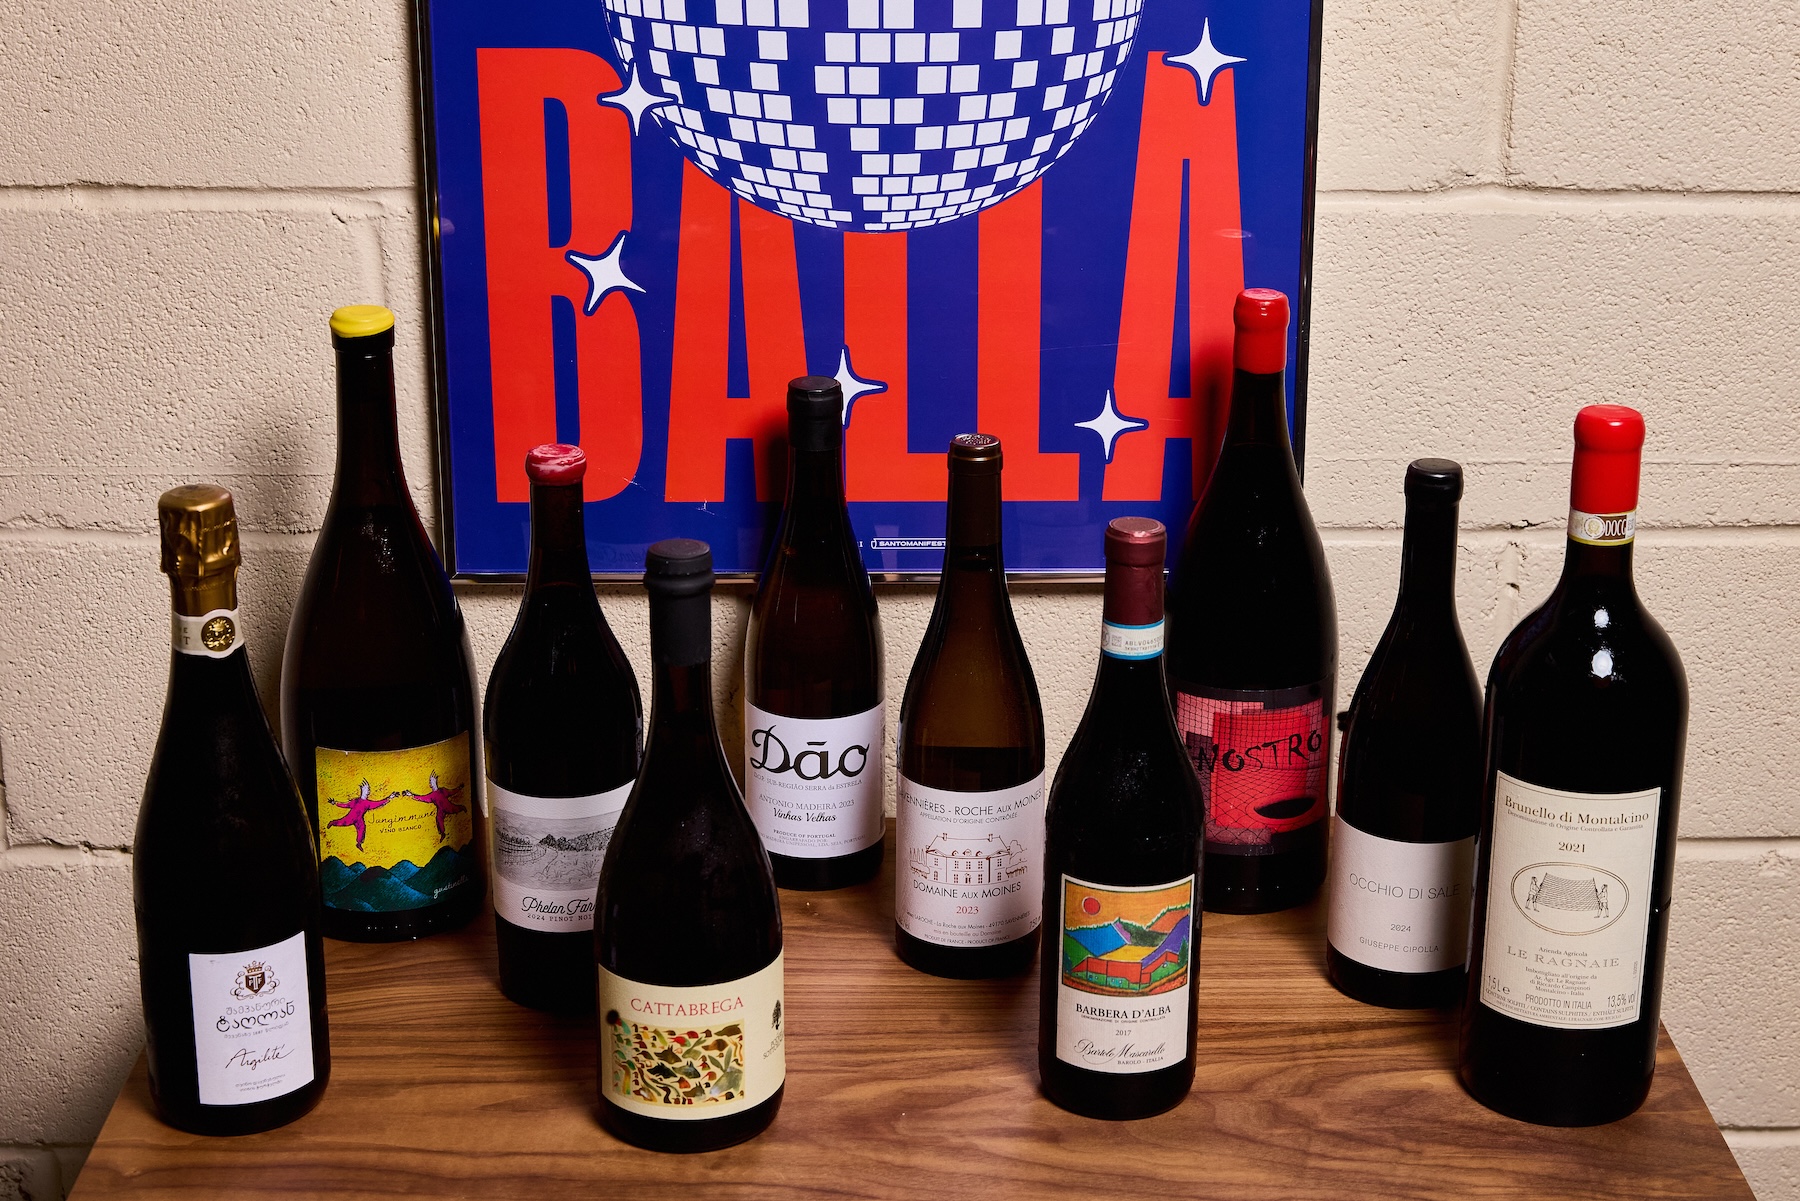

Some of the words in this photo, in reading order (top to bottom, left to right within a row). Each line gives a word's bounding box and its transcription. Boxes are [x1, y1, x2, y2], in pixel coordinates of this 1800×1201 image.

[750, 724, 870, 780] Dão
[836, 780, 862, 790] ESTRELA
[796, 802, 838, 810] MADEIRA
[838, 799, 855, 808] 2023
[954, 806, 994, 816] ROCHE
[996, 804, 1012, 814] AUX
[1014, 788, 1042, 810] MOINES
[773, 808, 802, 822] Vinhas
[806, 812, 837, 822] Velhas
[1505, 795, 1556, 820] Brunello
[1560, 812, 1572, 822] di
[1578, 812, 1650, 824] Montalcino
[920, 811, 952, 823] APPELLATION
[1508, 809, 1548, 826] Denominazione
[1556, 822, 1578, 831] Origine
[1620, 824, 1644, 832] Garantita
[398, 824, 422, 832] BIANCO
[773, 829, 800, 838] PRODUCE
[1558, 841, 1586, 853] 2021
[914, 879, 958, 898] DOMAINE
[962, 890, 978, 898] AUX
[982, 882, 1022, 898] MOINES
[1350, 873, 1404, 898] OCCHIO
[1408, 888, 1423, 899] DI
[1428, 884, 1460, 900] SALE
[521, 896, 566, 914] Phelan
[956, 906, 979, 915] 2023
[1390, 924, 1411, 932] 2024
[1360, 936, 1399, 952] GIUSEPPE
[1402, 945, 1440, 954] CIPOLLA
[1538, 946, 1562, 956] Azienda
[1506, 946, 1528, 960] LE
[1534, 954, 1620, 968] RAGNAIE
[1535, 986, 1566, 995] Montalcino
[1536, 980, 1560, 988] Riccardo
[630, 996, 744, 1016] CATTABREGA
[1526, 994, 1562, 1008] PRODOTTO
[1563, 1000, 1570, 1009] IN
[1572, 1000, 1592, 1010] ITALIA
[1608, 993, 1627, 1008] 13,5%
[1076, 1004, 1128, 1018] BARBERA
[1530, 1005, 1556, 1015] CONTAINS
[1074, 1038, 1116, 1057] Bartolo
